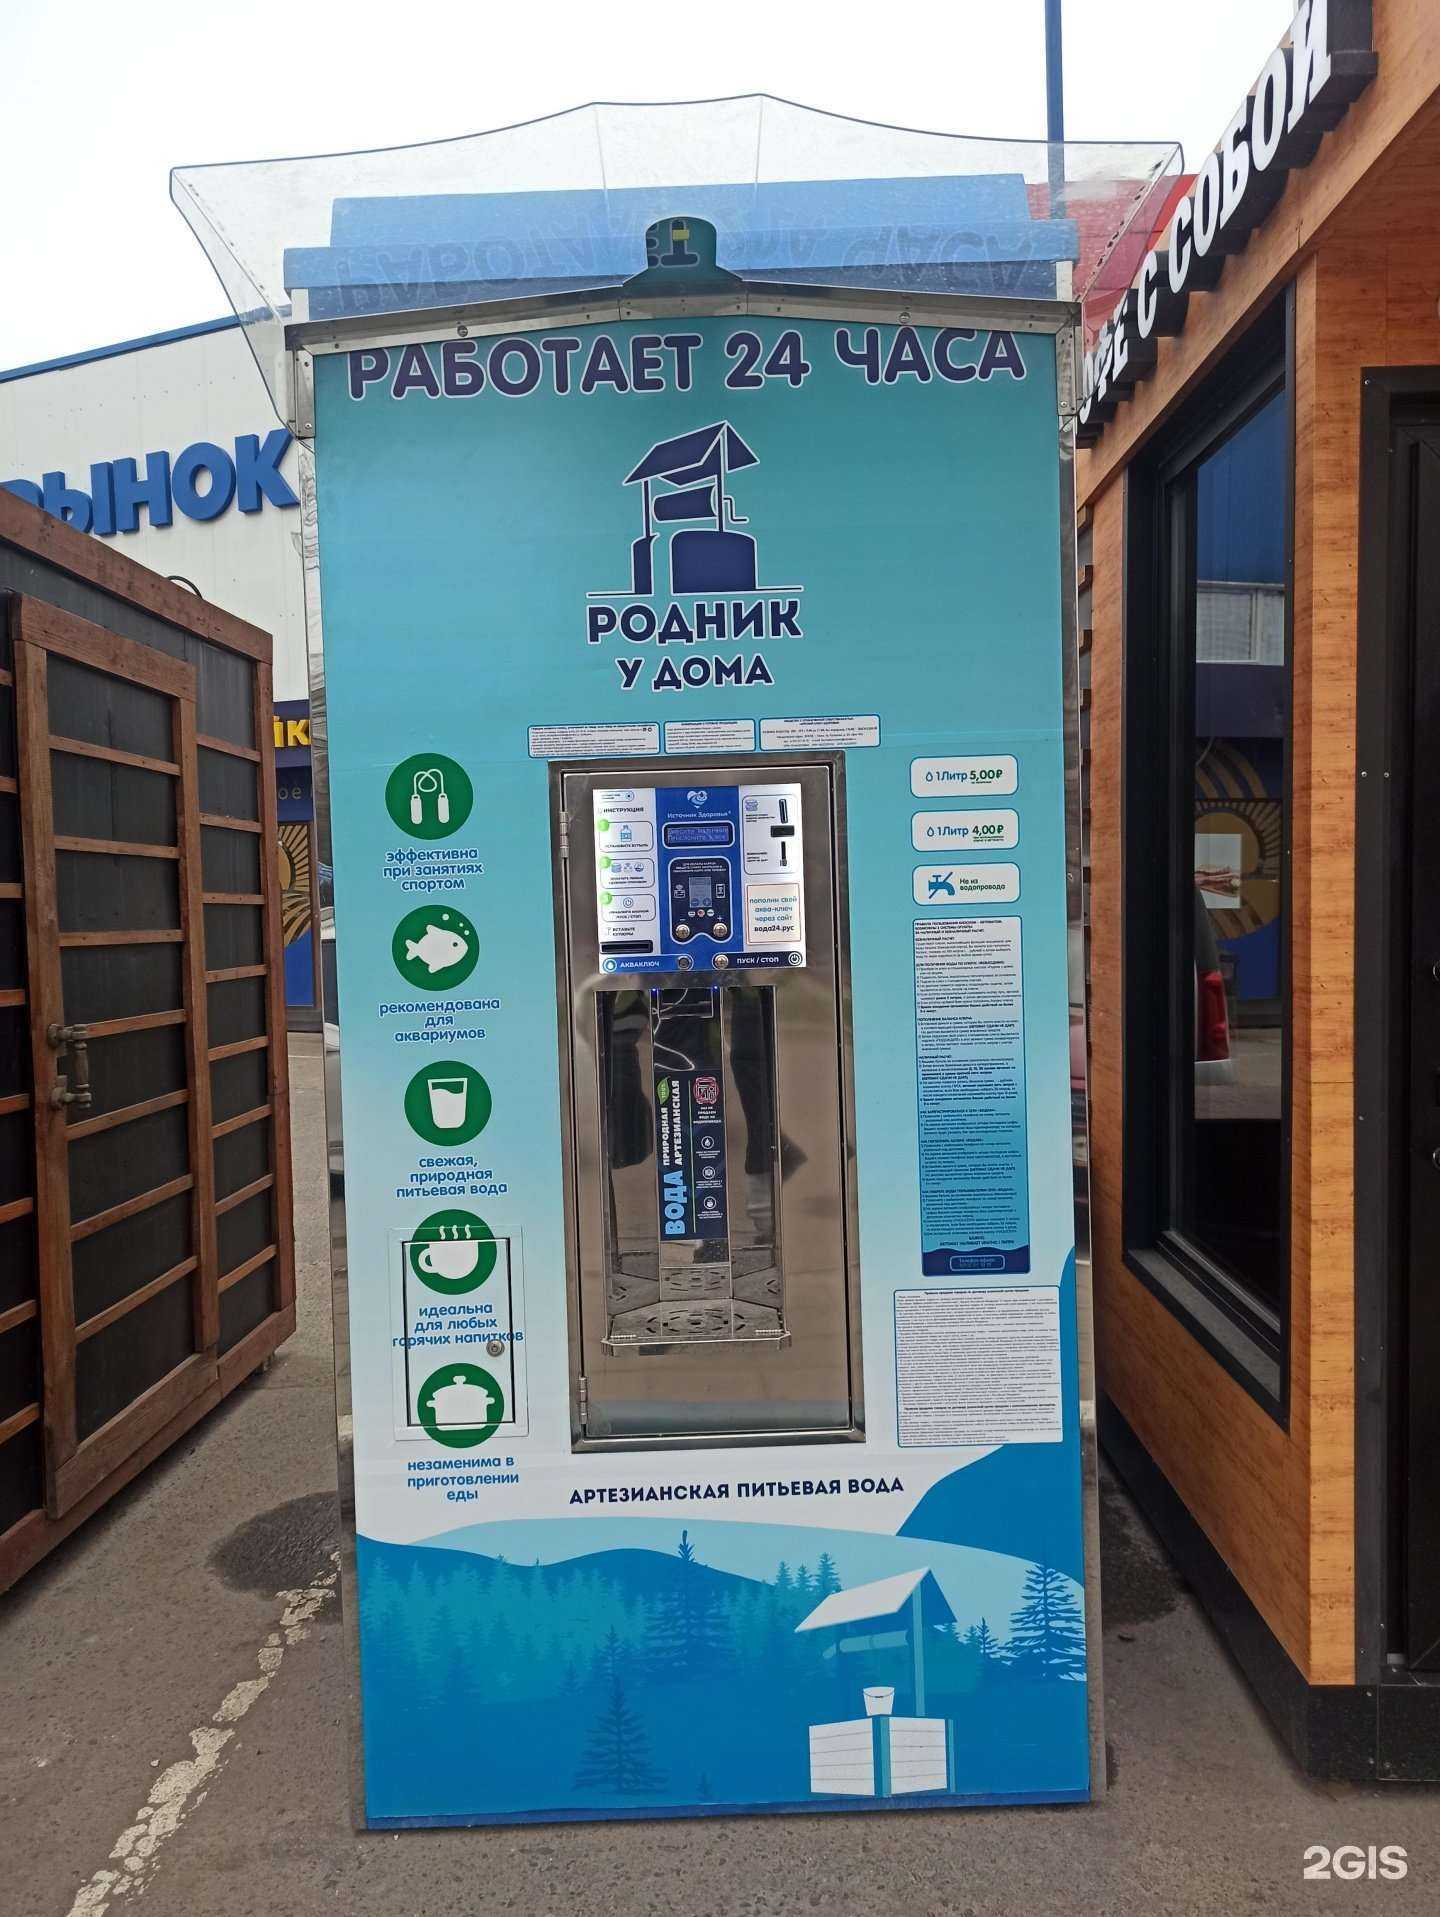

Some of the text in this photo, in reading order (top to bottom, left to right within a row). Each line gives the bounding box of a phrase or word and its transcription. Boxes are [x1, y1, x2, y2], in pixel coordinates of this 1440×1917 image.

[1138, 250, 1158, 339] С
[349, 327, 1026, 400] РАБОТАЕТ 24 ЧАСА
[587, 599, 803, 645] РОДНИК
[615, 653, 774, 691] У ДОМА
[386, 848, 478, 865] эффективна
[383, 862, 483, 879] при занятиях
[401, 879, 465, 892] спортом
[960, 884, 1006, 892] водопровода
[749, 897, 778, 905] пополни
[754, 914, 793, 924] через сайт
[754, 924, 795, 934] вода24.рус
[736, 957, 755, 965] ПУСК
[760, 956, 779, 964] СТОП
[379, 998, 500, 1017] рекомендована
[424, 1014, 453, 1029] для
[394, 1027, 486, 1044] аквариумов
[671, 1080, 683, 1166] АРТЕЗИАНСКАЯ
[661, 1107, 671, 1166] ПРИРОДНАЯ
[418, 1156, 478, 1169] свежая,
[409, 1169, 493, 1184] природная
[396, 1183, 507, 1199] питьевая вода
[664, 1170, 688, 1235] ВОДА
[418, 1303, 493, 1319] идеальна
[414, 1317, 498, 1333] для любых
[392, 1331, 524, 1350] горячих напитков
[408, 1457, 514, 1472] незаменима в
[408, 1472, 519, 1490] приготовлении
[447, 1490, 478, 1502] еды
[569, 1477, 905, 1505] АРТЕЗИАНСКАЯ ПИТЬЕВАЯ ВОДА
